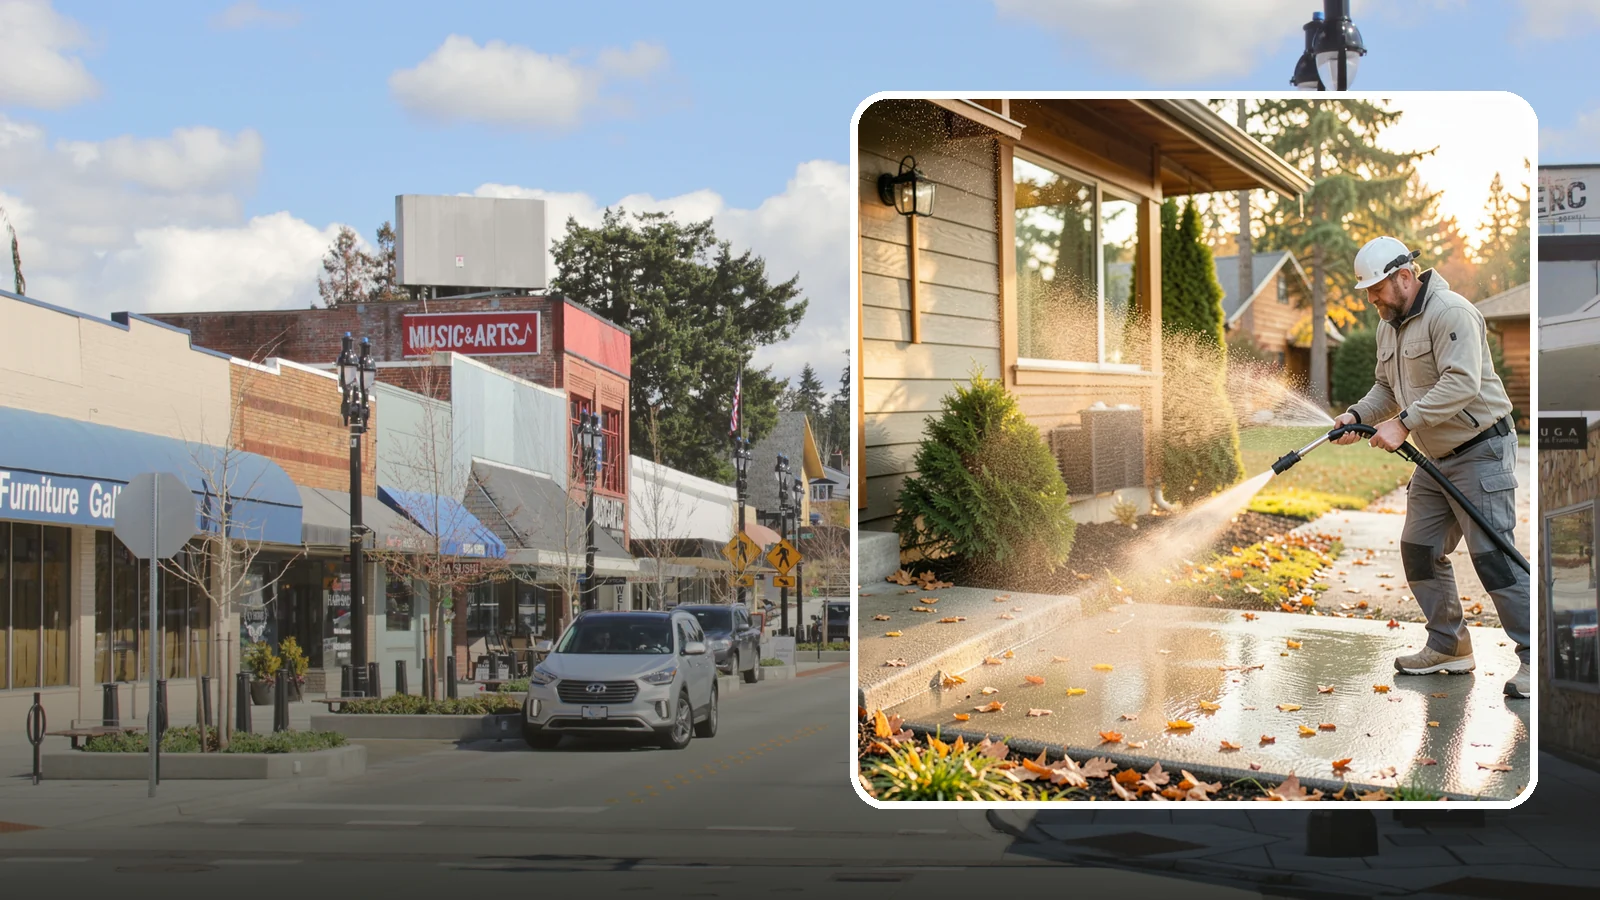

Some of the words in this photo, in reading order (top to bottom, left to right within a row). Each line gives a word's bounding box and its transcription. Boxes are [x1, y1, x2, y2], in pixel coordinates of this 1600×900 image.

[1540, 427, 1577, 437] UGA
[0, 471, 79, 515] Furniture
[453, 563, 479, 574] SUSHI
